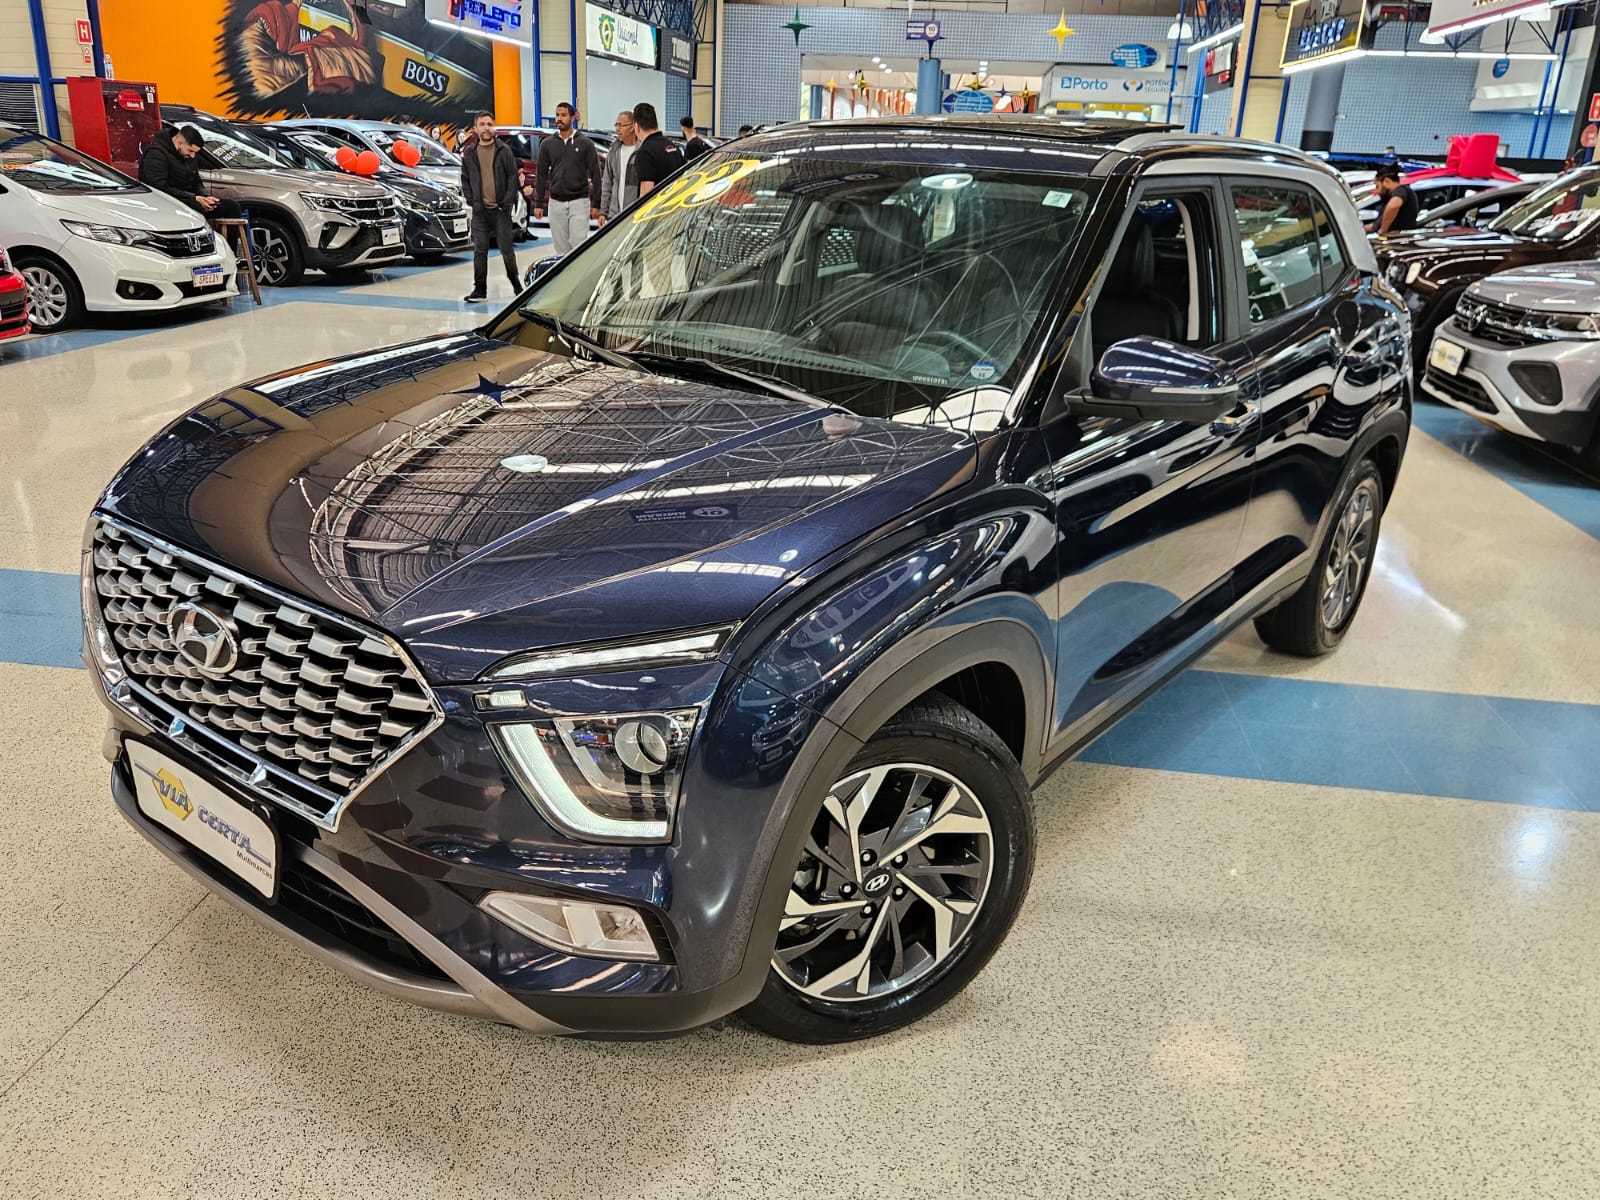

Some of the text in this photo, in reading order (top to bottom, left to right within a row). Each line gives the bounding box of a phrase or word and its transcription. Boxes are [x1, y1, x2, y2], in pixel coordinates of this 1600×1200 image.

[80, 24, 89, 39] H
[405, 60, 447, 93] BOSS
[1073, 77, 1109, 91] Porto
[1145, 79, 1178, 88] POTÊNCA
[158, 779, 251, 853] VIA CERTA
[236, 850, 272, 879] Multimarcas
